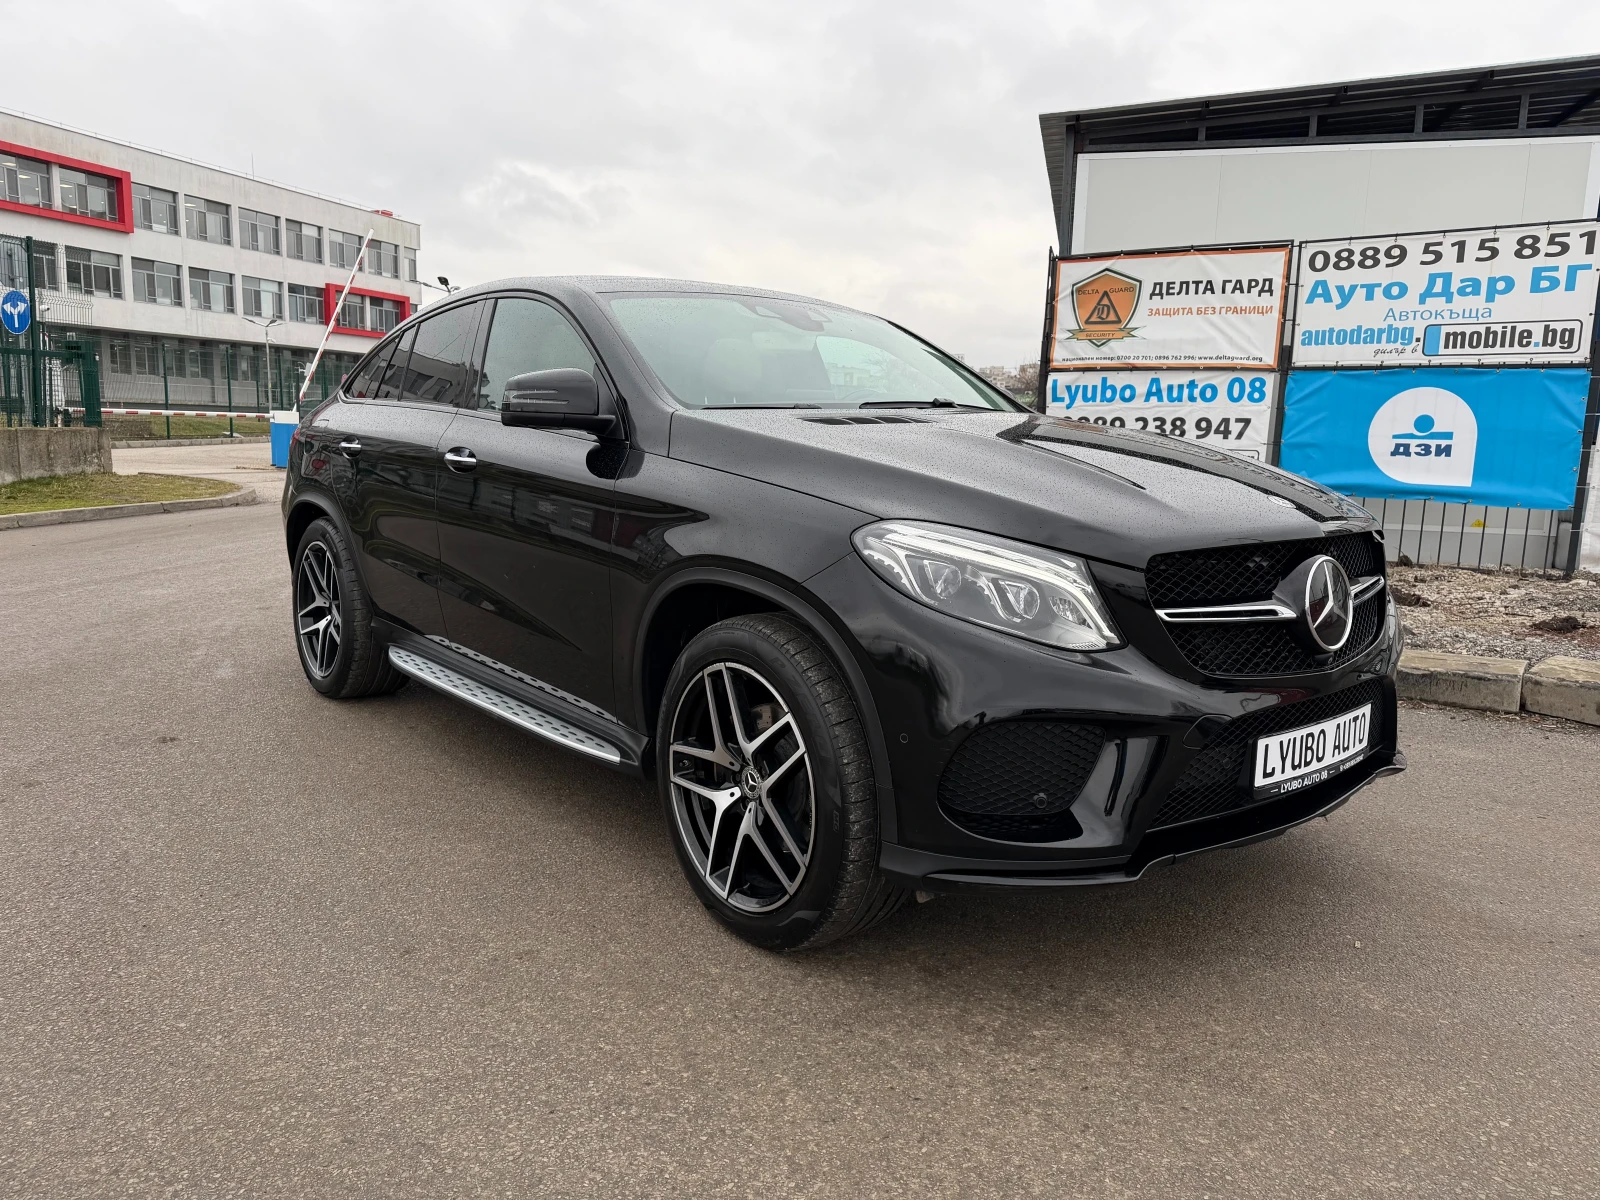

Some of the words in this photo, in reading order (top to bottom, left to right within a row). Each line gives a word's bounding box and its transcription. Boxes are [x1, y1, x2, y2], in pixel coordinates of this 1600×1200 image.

[1308, 244, 1408, 272] 0889
[1419, 237, 1500, 266] 515
[1513, 230, 1597, 260] 851
[1149, 280, 1216, 300] ДЕЛТА
[1221, 278, 1274, 297] ГАРД
[1305, 280, 1409, 310] Ауто
[1418, 272, 1516, 305] Дар
[1529, 264, 1592, 294] БГ
[1148, 307, 1194, 318] ЗАЩИТА
[1196, 306, 1216, 316] БЕЗ
[1219, 306, 1274, 316] ГРАНИЦИ
[1383, 307, 1492, 322] Автокъща
[1444, 324, 1576, 350] mobile.bg
[1051, 377, 1136, 410] Lyubo
[1144, 378, 1218, 403] Auto
[1226, 377, 1266, 403] 08
[1134, 416, 1186, 438] 238
[1194, 417, 1252, 440] 947
[1262, 728, 1326, 779] LYUBO
[1332, 712, 1366, 758] AUTO
[1280, 780, 1302, 794] LYUBO
[1303, 773, 1320, 786] AUTO
